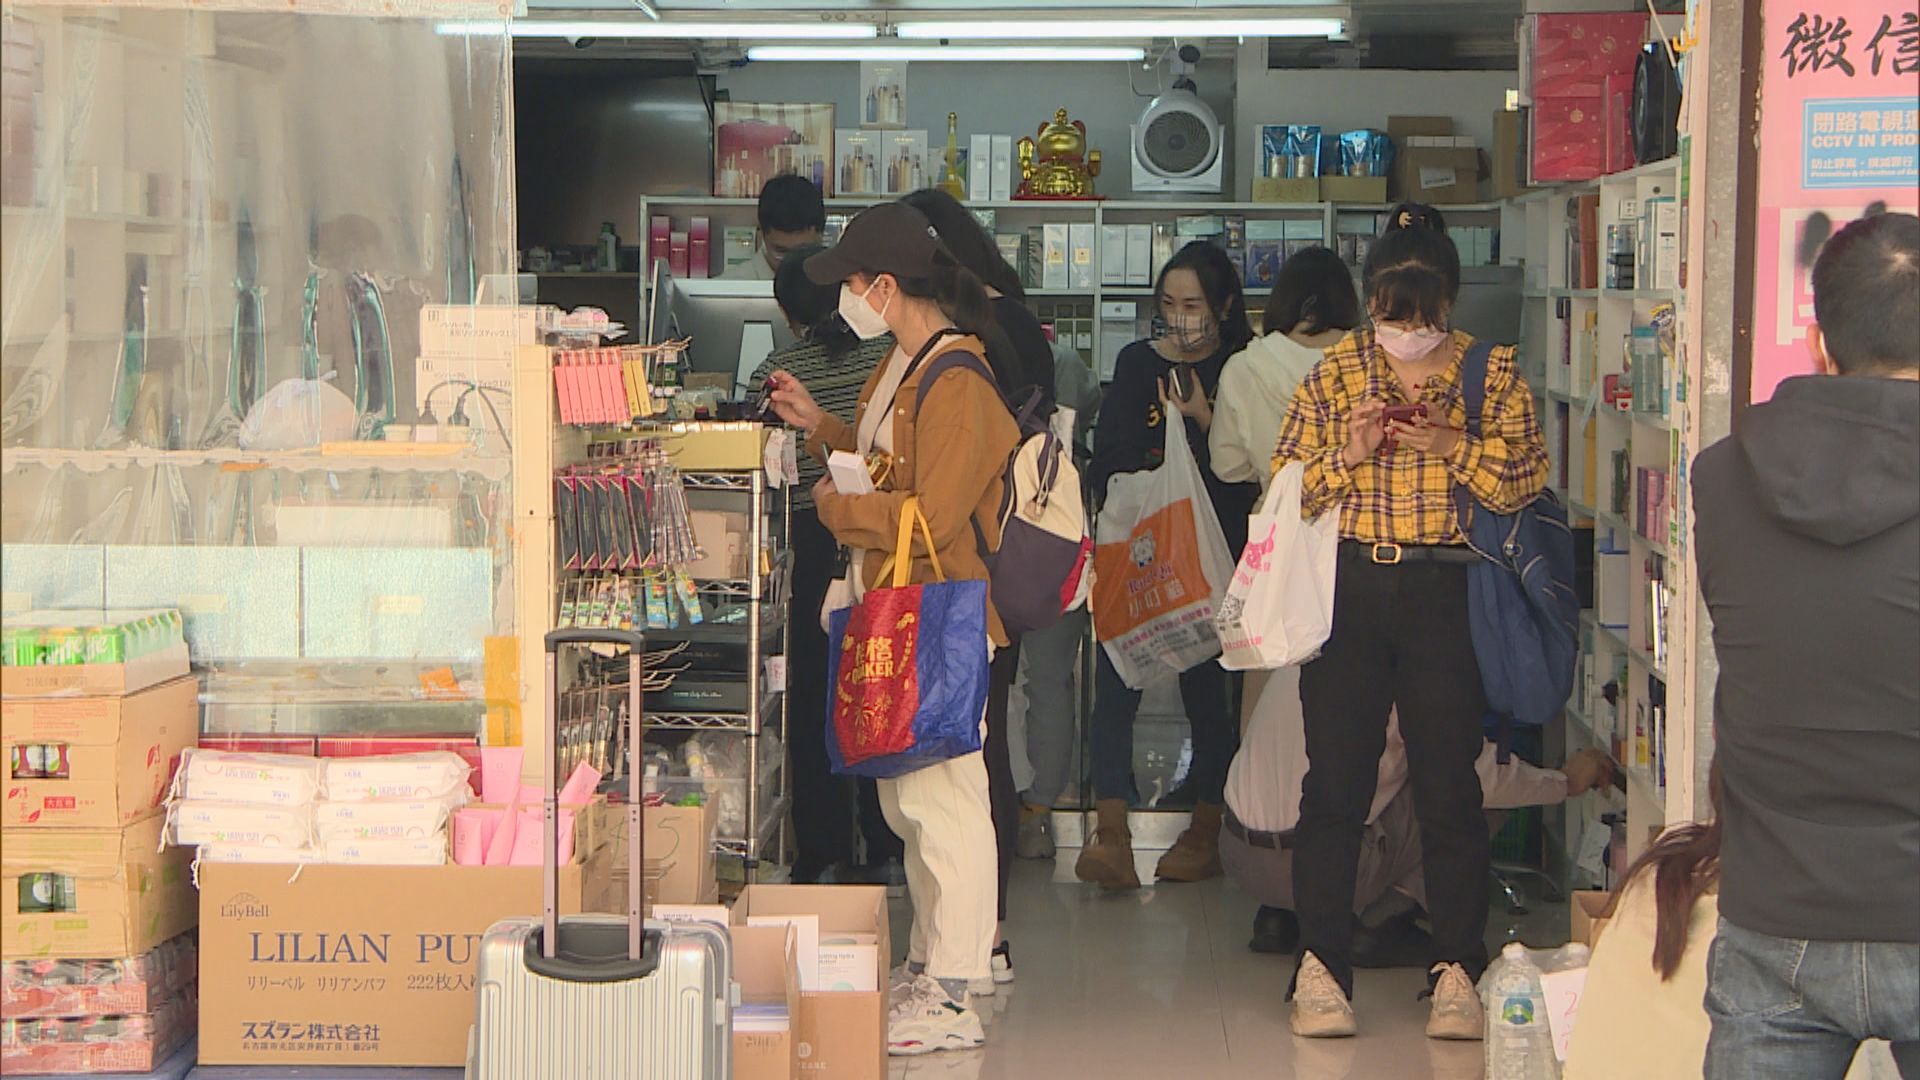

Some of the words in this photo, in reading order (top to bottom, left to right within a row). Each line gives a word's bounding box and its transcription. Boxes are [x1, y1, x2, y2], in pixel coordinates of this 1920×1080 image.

[1780, 12, 1919, 79] 微信
[1812, 134, 1854, 148] CCTV
[1858, 134, 1876, 147] IN
[1881, 133, 1919, 147] PRO
[221, 904, 269, 920] LilyBell
[249, 932, 392, 963] LILIAN
[415, 933, 484, 964] PU
[247, 975, 305, 991] リリーベル
[317, 976, 386, 991] リリアンパフ
[241, 1020, 381, 1041] スズラン株式会社
